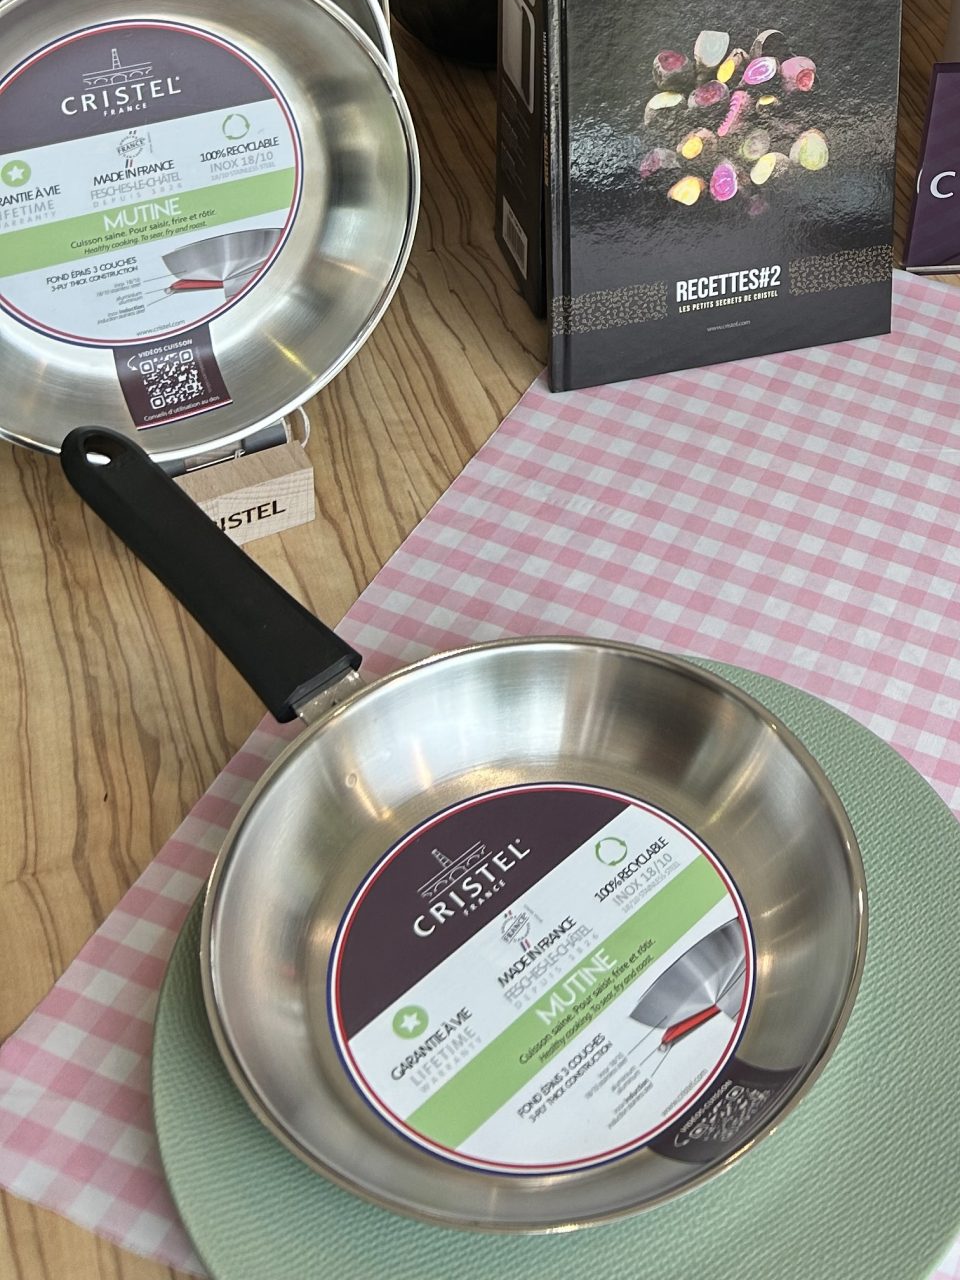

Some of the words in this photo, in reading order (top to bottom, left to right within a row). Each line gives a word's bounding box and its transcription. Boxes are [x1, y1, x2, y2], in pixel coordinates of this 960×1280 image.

[61, 77, 181, 116] CRISTEL
[103, 103, 147, 117] FRANCE
[200, 149, 226, 163] 100%
[226, 136, 280, 156] RECYCLABLE
[210, 159, 238, 173] INOX
[240, 151, 273, 167] 18/10
[94, 171, 124, 186] MADE
[125, 169, 137, 179] IN
[137, 160, 175, 176] FRANCE
[43, 184, 62, 196] VIE
[103, 197, 182, 231] MUTINE
[70, 237, 102, 249] Cuisson
[128, 226, 148, 235] Pour
[172, 216, 188, 226] frire
[84, 242, 110, 255] Healthy
[46, 274, 70, 285] FOND
[100, 256, 138, 272] COUCHES
[676, 265, 781, 303] RECETTES#2
[678, 306, 691, 314] LES
[692, 301, 714, 312] PETITS
[716, 296, 742, 307] SECRETS
[744, 294, 752, 302] DE
[754, 290, 778, 301] CRISTEL
[164, 339, 193, 352] CUISSON
[214, 500, 287, 532] ISTEL
[617, 836, 670, 882] RECYCLABLE
[413, 843, 531, 938] CRISTEL
[612, 878, 643, 907] INOX
[640, 852, 673, 882] 18/10
[463, 879, 506, 917] FRANCE
[498, 954, 530, 988] MADE
[537, 915, 577, 953] FRANCE
[535, 948, 618, 1026] MUTINE
[520, 1033, 552, 1064] Cuisson
[572, 995, 593, 1014] Pour
